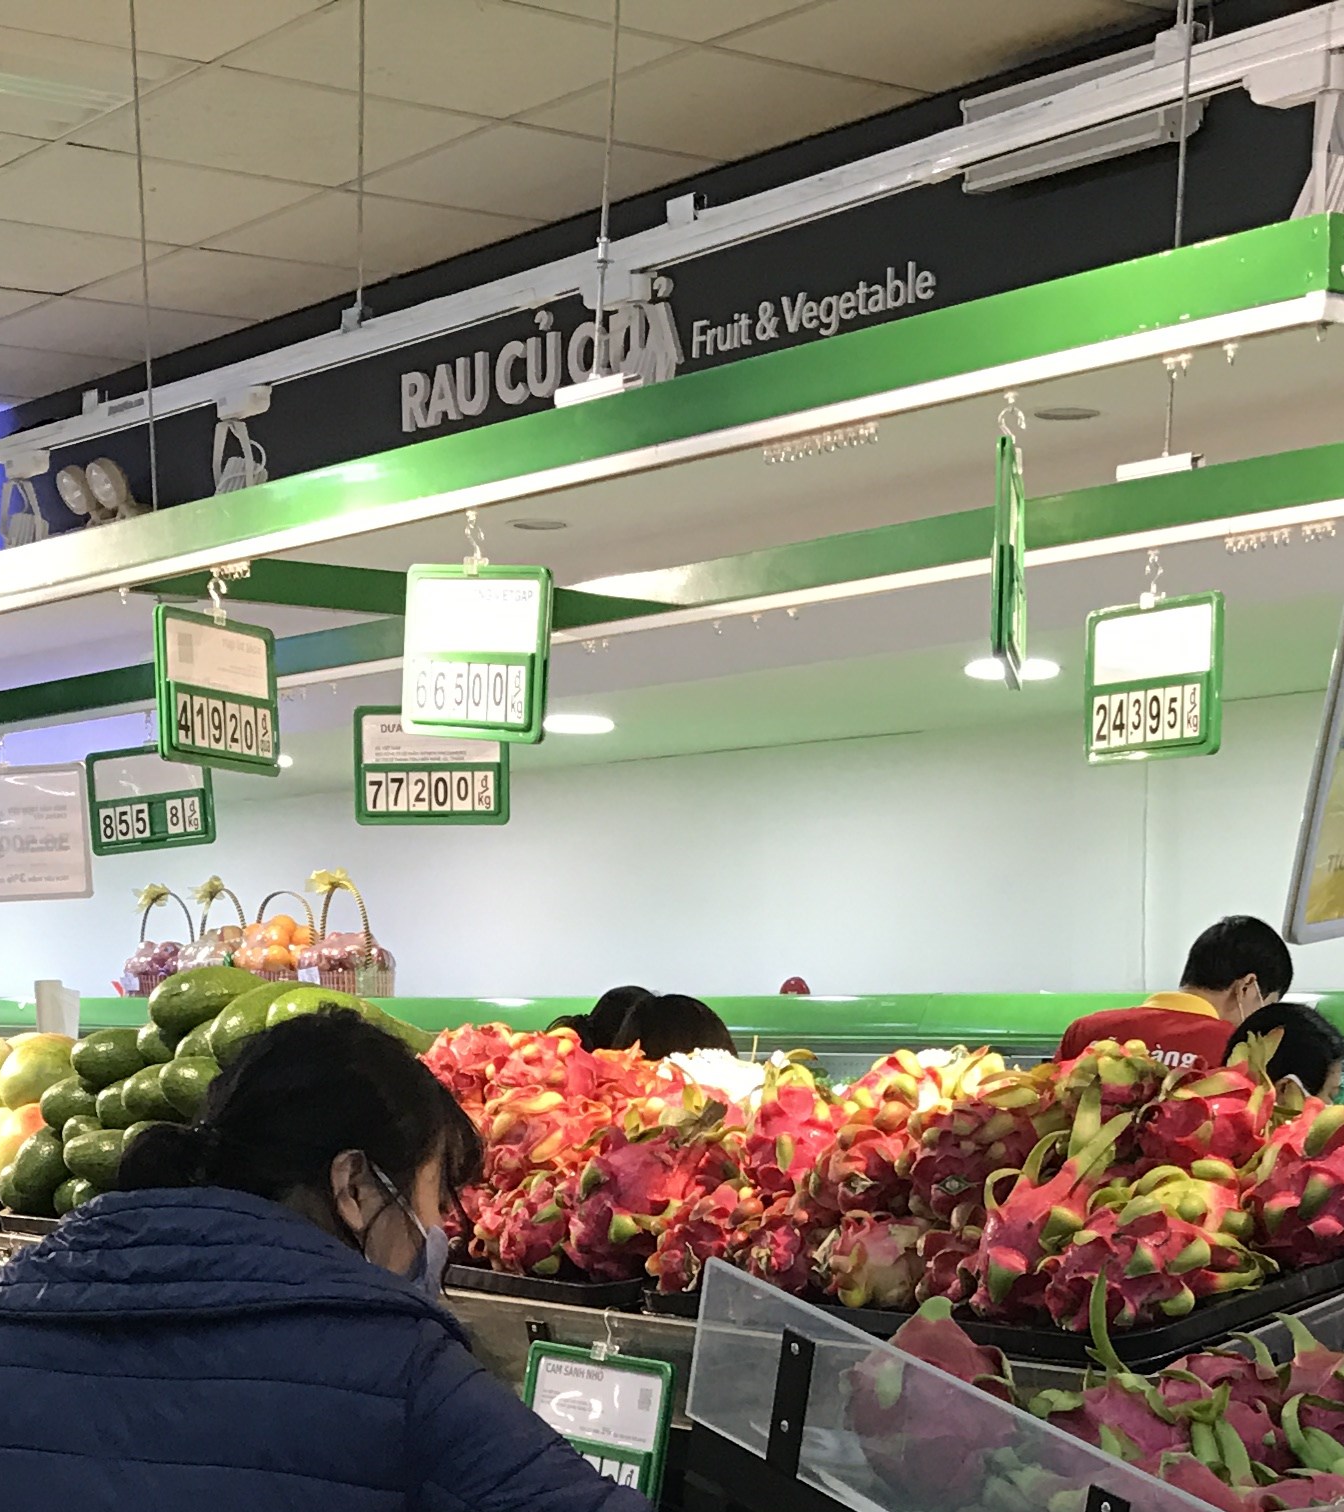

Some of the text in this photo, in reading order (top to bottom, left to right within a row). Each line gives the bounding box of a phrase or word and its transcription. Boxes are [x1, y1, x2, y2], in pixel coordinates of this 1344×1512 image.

[401, 349, 490, 432] RAU
[495, 311, 561, 404] CỦ
[691, 313, 752, 359] Fruit
[755, 302, 778, 340] &
[780, 261, 936, 337] Vegetable
[102, 808, 147, 839] 855
[1145, 1044, 1198, 1069] àng
